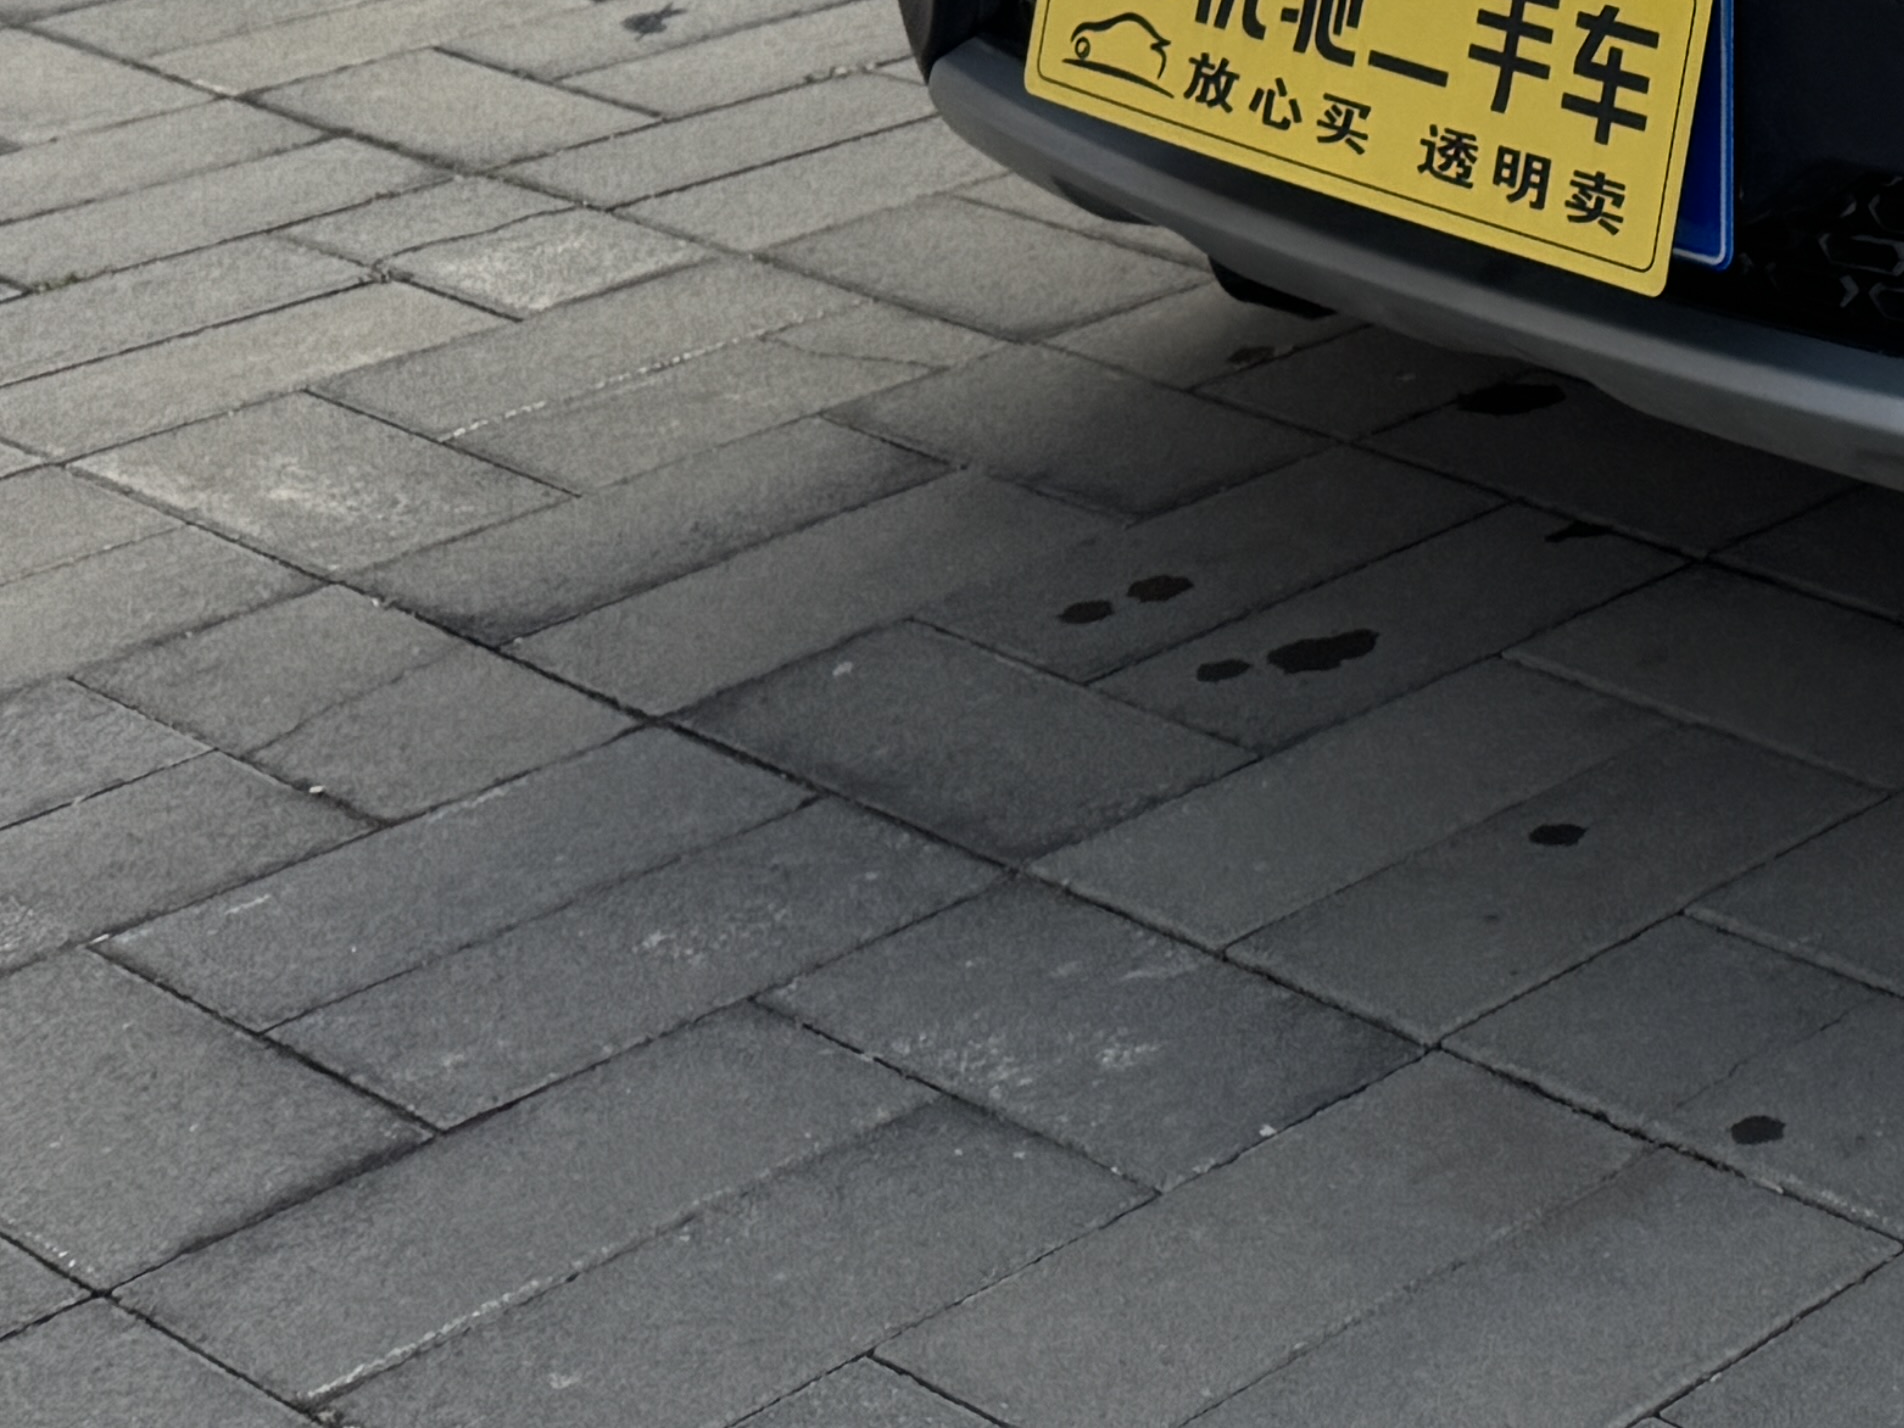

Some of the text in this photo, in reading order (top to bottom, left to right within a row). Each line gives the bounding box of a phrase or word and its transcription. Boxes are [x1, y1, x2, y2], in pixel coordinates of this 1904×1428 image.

[1184, 51, 1627, 236] 放心买 透明卖
